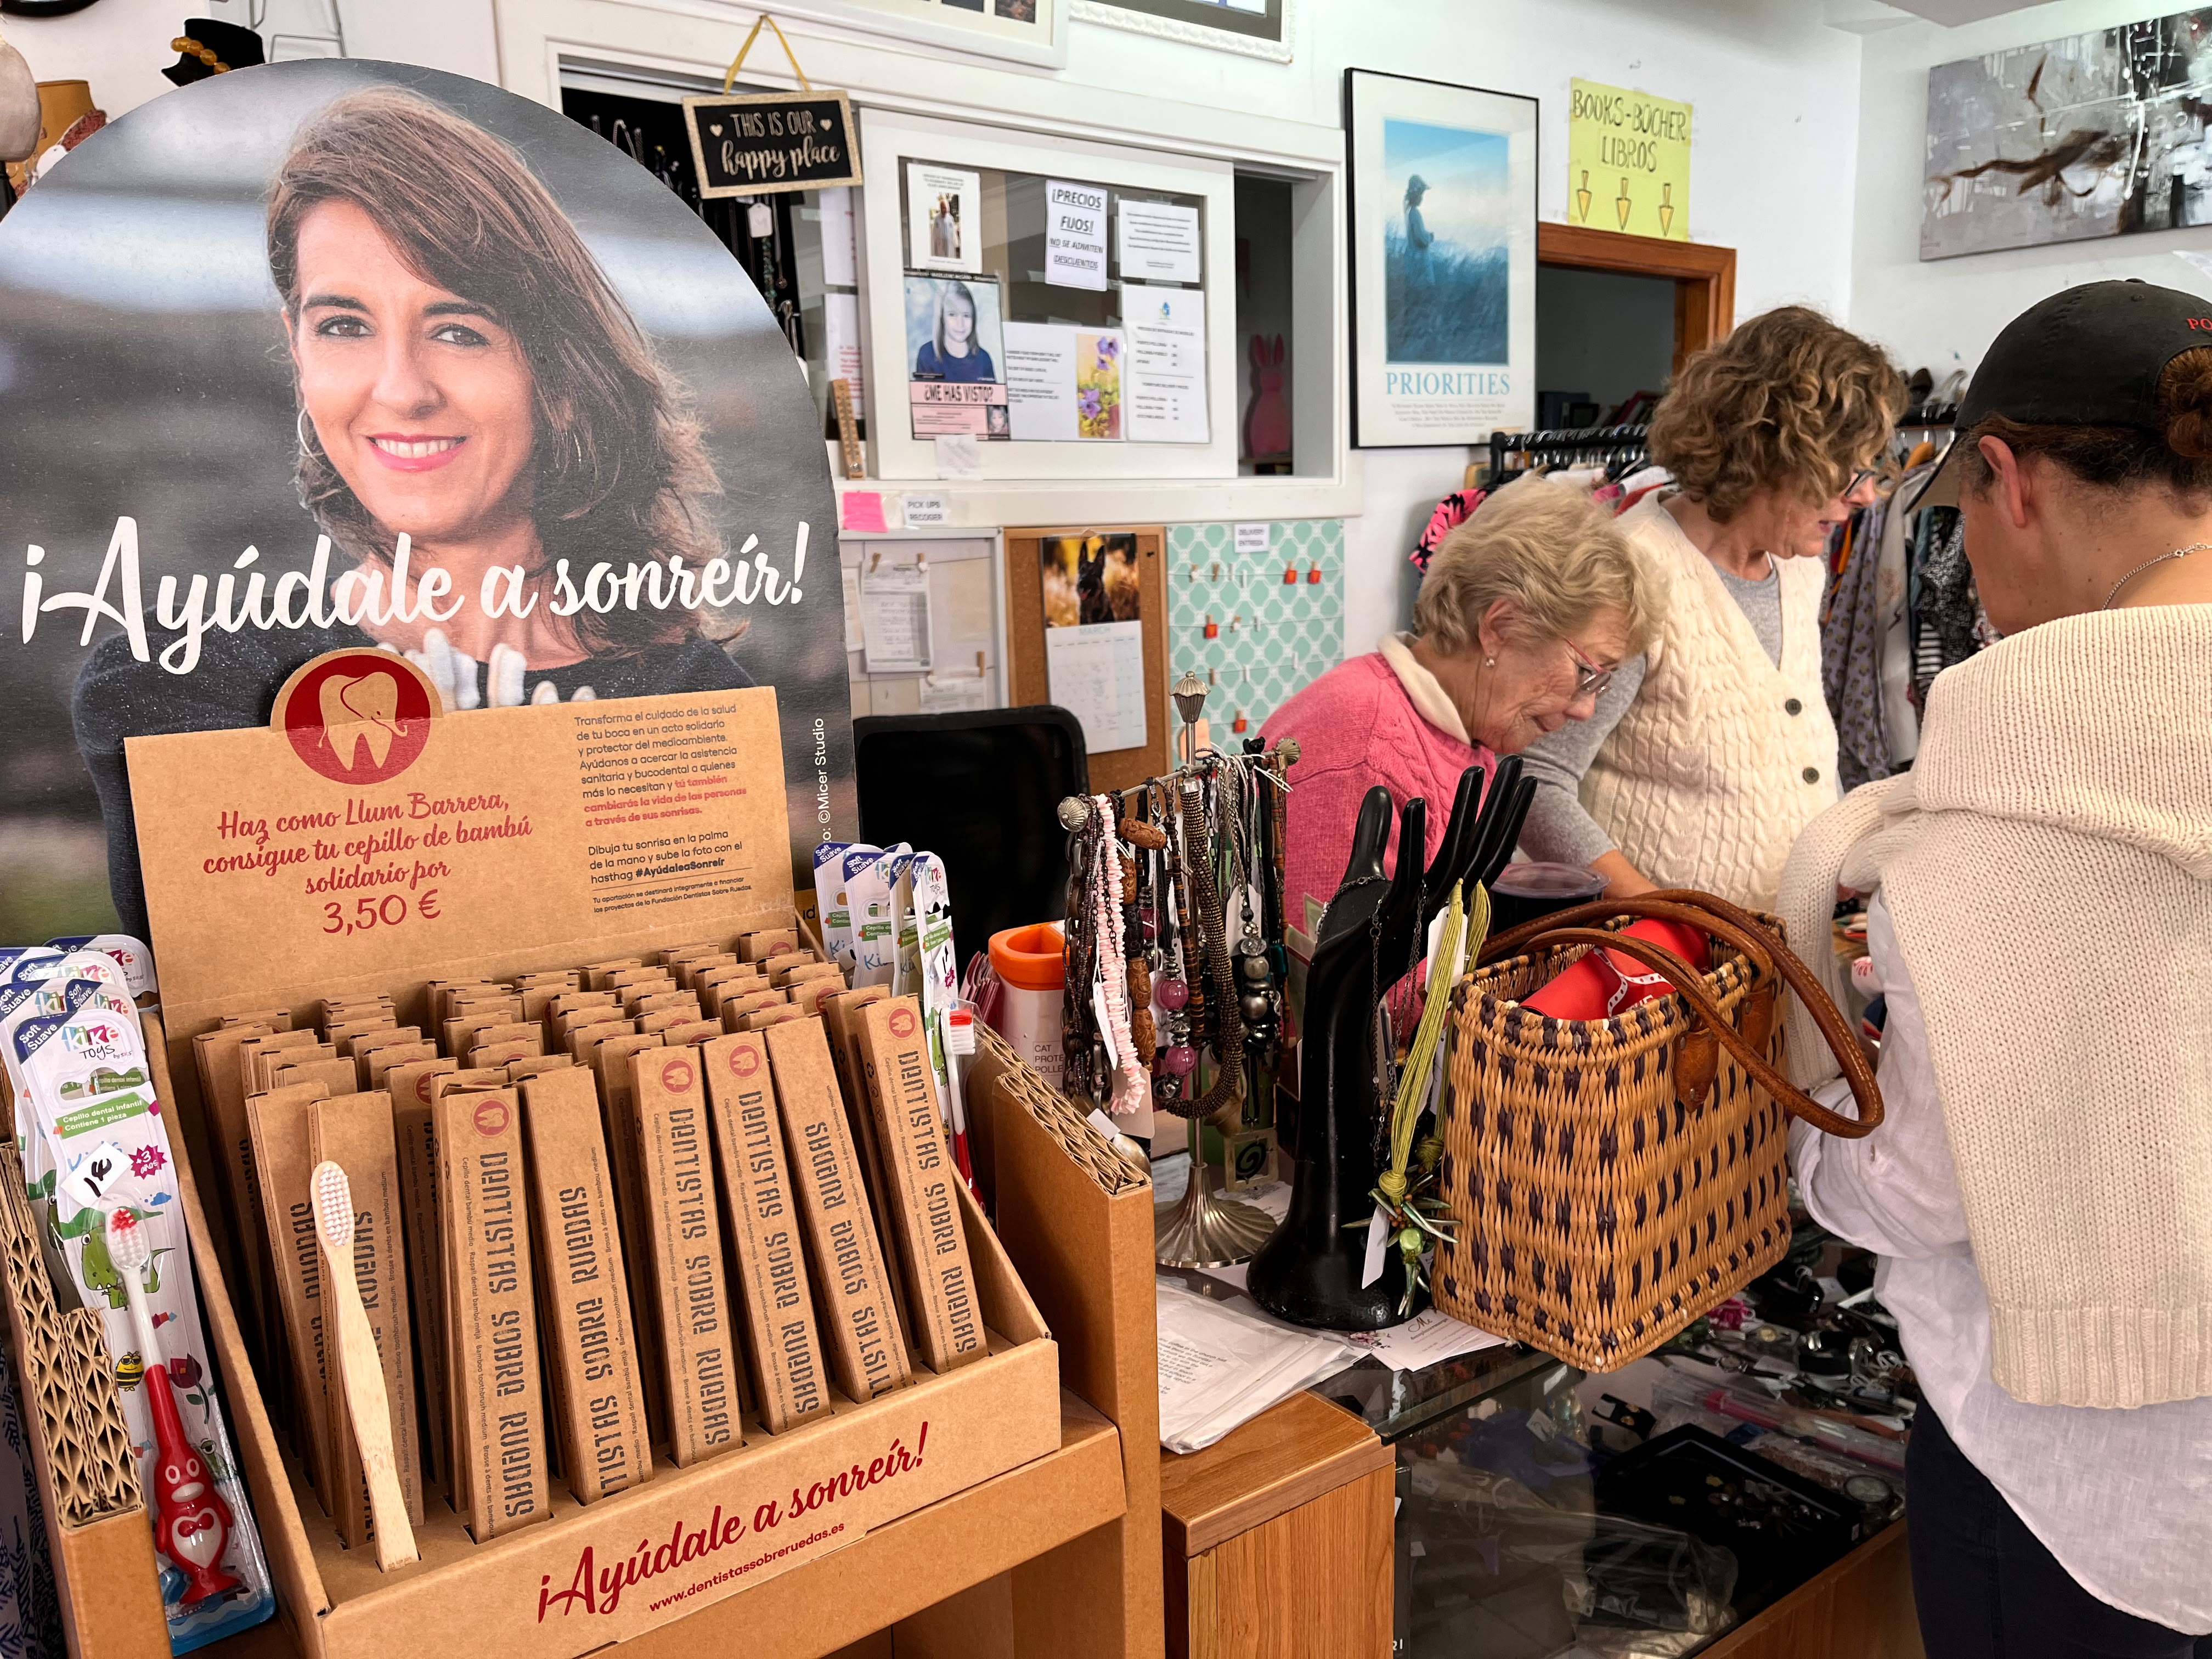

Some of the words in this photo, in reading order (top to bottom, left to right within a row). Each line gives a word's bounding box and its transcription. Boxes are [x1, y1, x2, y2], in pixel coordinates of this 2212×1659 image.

[729, 112, 765, 138] THIS
[768, 111, 783, 137] IS
[786, 110, 816, 135] OUR
[721, 140, 788, 180] happy
[789, 136, 840, 177] place
[1602, 136, 1657, 173] LIBROS
[1052, 188, 1102, 211] ¡PRECIOS
[1060, 216, 1094, 234] FIJOS!
[944, 385, 962, 402] HAS
[1386, 372, 1510, 395] PRIORITIES
[22, 516, 465, 675] ¡Ayúdale
[480, 564, 538, 619] a
[549, 521, 810, 616] sonreír!
[573, 713, 633, 726] Transforma
[634, 710, 644, 721] el
[645, 708, 685, 720] cuidado
[686, 707, 699, 717] de
[699, 706, 709, 715] la
[710, 703, 737, 715] salud
[575, 730, 590, 741] de
[591, 730, 603, 740] tu
[603, 728, 630, 738] boca
[631, 727, 645, 736] en
[646, 726, 659, 735] un
[661, 723, 684, 733] acto
[685, 719, 725, 731] solidario
[812, 718, 827, 766] Studio
[577, 747, 584, 758] y
[585, 742, 633, 757] protector
[634, 739, 650, 750] del
[652, 733, 728, 748] medioambiente.
[579, 758, 629, 771] Ayúdanos
[630, 757, 638, 765] a
[639, 753, 678, 764] acercar
[679, 750, 689, 760] la
[690, 745, 737, 759] asistencia
[580, 771, 625, 785] sanitaria
[626, 771, 633, 782] y
[634, 764, 690, 778] bucodental
[699, 761, 736, 774] quienes
[582, 787, 605, 799] más
[606, 786, 616, 796] lo
[617, 782, 665, 795] necesitan
[666, 781, 673, 792] y
[674, 779, 686, 788] tú
[686, 775, 727, 787] también
[583, 798, 639, 813] cambiarás
[639, 796, 650, 806] la
[651, 794, 673, 805] vida
[673, 792, 687, 803] de
[687, 791, 703, 801] las
[703, 788, 747, 801] personas
[217, 811, 270, 845] Haz
[276, 812, 341, 833] como
[345, 798, 404, 826] Llum
[407, 792, 509, 819] Barrera,
[593, 814, 627, 826] través
[627, 811, 641, 822] de
[641, 811, 659, 820] sus
[659, 806, 703, 818] sonrisas.
[203, 844, 309, 876] consigue
[312, 839, 339, 861] tu
[345, 826, 419, 864] cepillo
[423, 823, 451, 848] de
[456, 815, 533, 843] bambú
[588, 843, 620, 856] Dibuja
[621, 842, 633, 851] tu
[635, 837, 671, 850] sonrisa
[672, 836, 685, 845] en
[686, 833, 696, 843] la
[698, 830, 729, 844] palma
[589, 859, 603, 870] de
[604, 858, 614, 868] la
[616, 855, 646, 866] mano
[647, 854, 653, 864] y
[655, 850, 680, 861] sube
[681, 848, 690, 857] la
[691, 846, 713, 856] foto
[714, 844, 732, 853] con
[733, 840, 742, 850] el
[816, 844, 831, 856] Soft
[820, 847, 842, 862] Suave
[590, 871, 633, 884] hasthag
[635, 856, 725, 878] #AyúdaleaSonreír
[847, 855, 863, 868] Soft
[851, 857, 874, 874] Suave
[305, 862, 410, 895] solidario
[409, 860, 452, 890] por
[323, 894, 407, 936] 3,50
[417, 889, 441, 919] €
[19, 1024, 42, 1044] Soft
[27, 1024, 58, 1051] Suave
[63, 1113, 90, 1123] Cepillo
[91, 1107, 115, 1117] dental
[116, 1099, 142, 1111] infantil
[65, 1119, 99, 1132] Contiene
[107, 1112, 127, 1123] pieza
[461, 1156, 470, 1179] Cepillo
[464, 1180, 472, 1201] dental
[465, 1200, 474, 1225] bambú
[467, 1225, 475, 1246] medio
[468, 1251, 477, 1275] Raspall
[470, 1276, 479, 1297] dental
[538, 1504, 748, 1624] ¡Ayúdale
[752, 1500, 783, 1533] a
[787, 1421, 930, 1520] sonreír!
[648, 1521, 846, 1613] www.dentistassobreruedas.es
